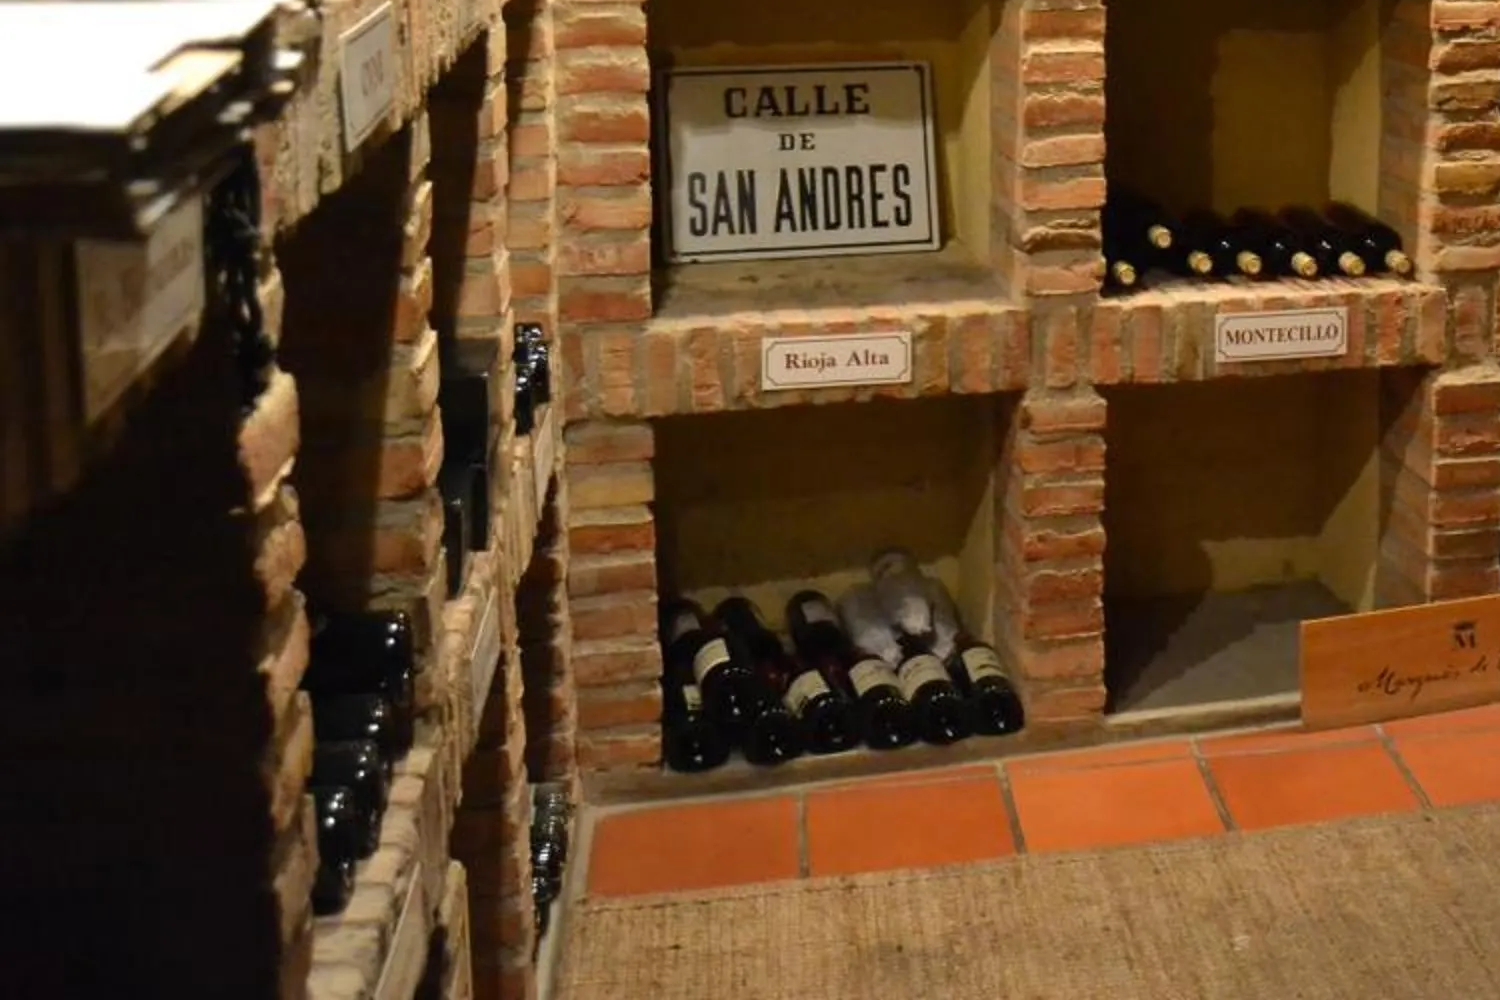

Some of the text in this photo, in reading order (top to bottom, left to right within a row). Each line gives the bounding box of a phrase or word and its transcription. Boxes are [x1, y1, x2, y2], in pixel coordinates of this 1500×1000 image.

[724, 83, 870, 118] CALLE
[778, 133, 815, 151] DE
[688, 163, 913, 237] SAN ANDRES
[1225, 322, 1339, 345] MONTECILLO
[785, 349, 889, 374] Rioja Alta
